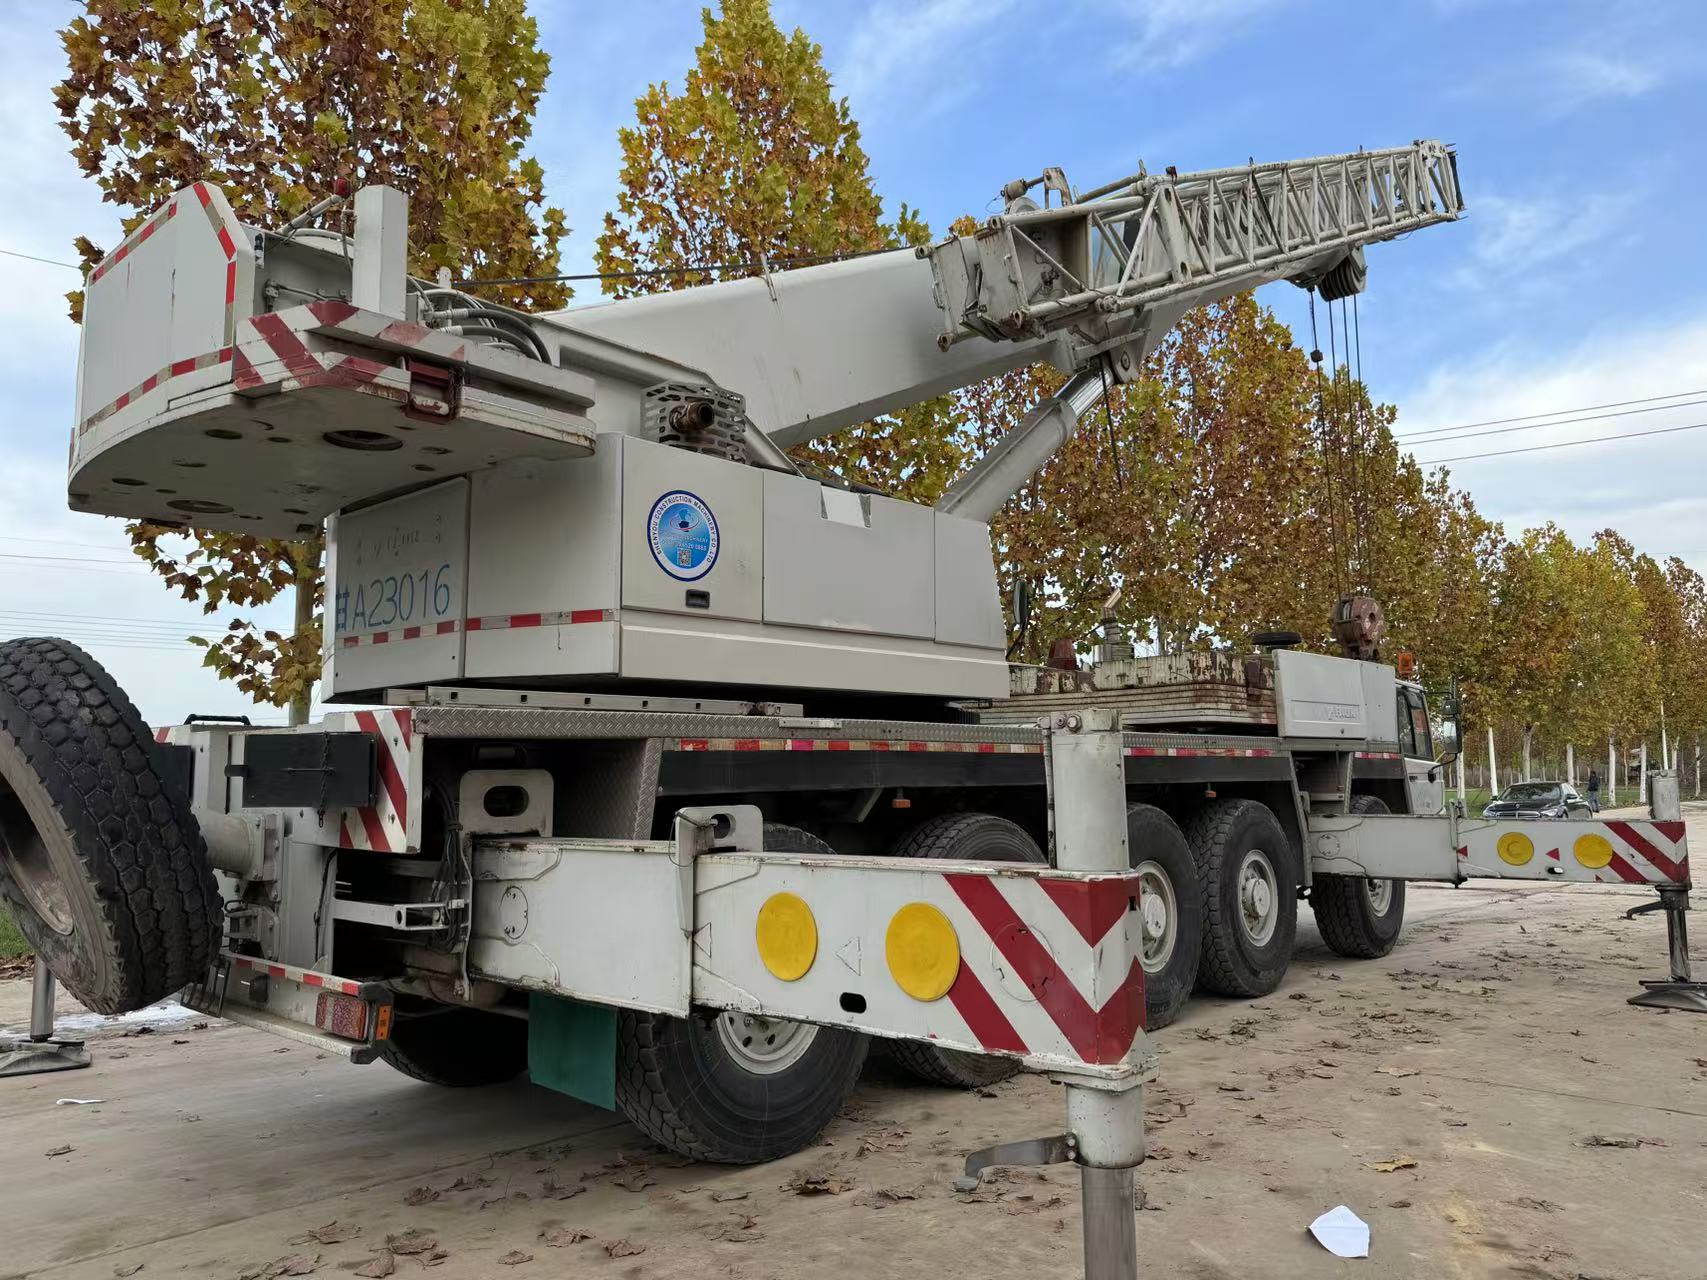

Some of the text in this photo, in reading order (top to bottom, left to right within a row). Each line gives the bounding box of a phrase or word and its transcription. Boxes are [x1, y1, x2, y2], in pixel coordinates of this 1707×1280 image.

[654, 495, 692, 519] CONSTRUCTION
[693, 501, 717, 535] MACHINERY
[652, 521, 661, 554] SHENYOU
